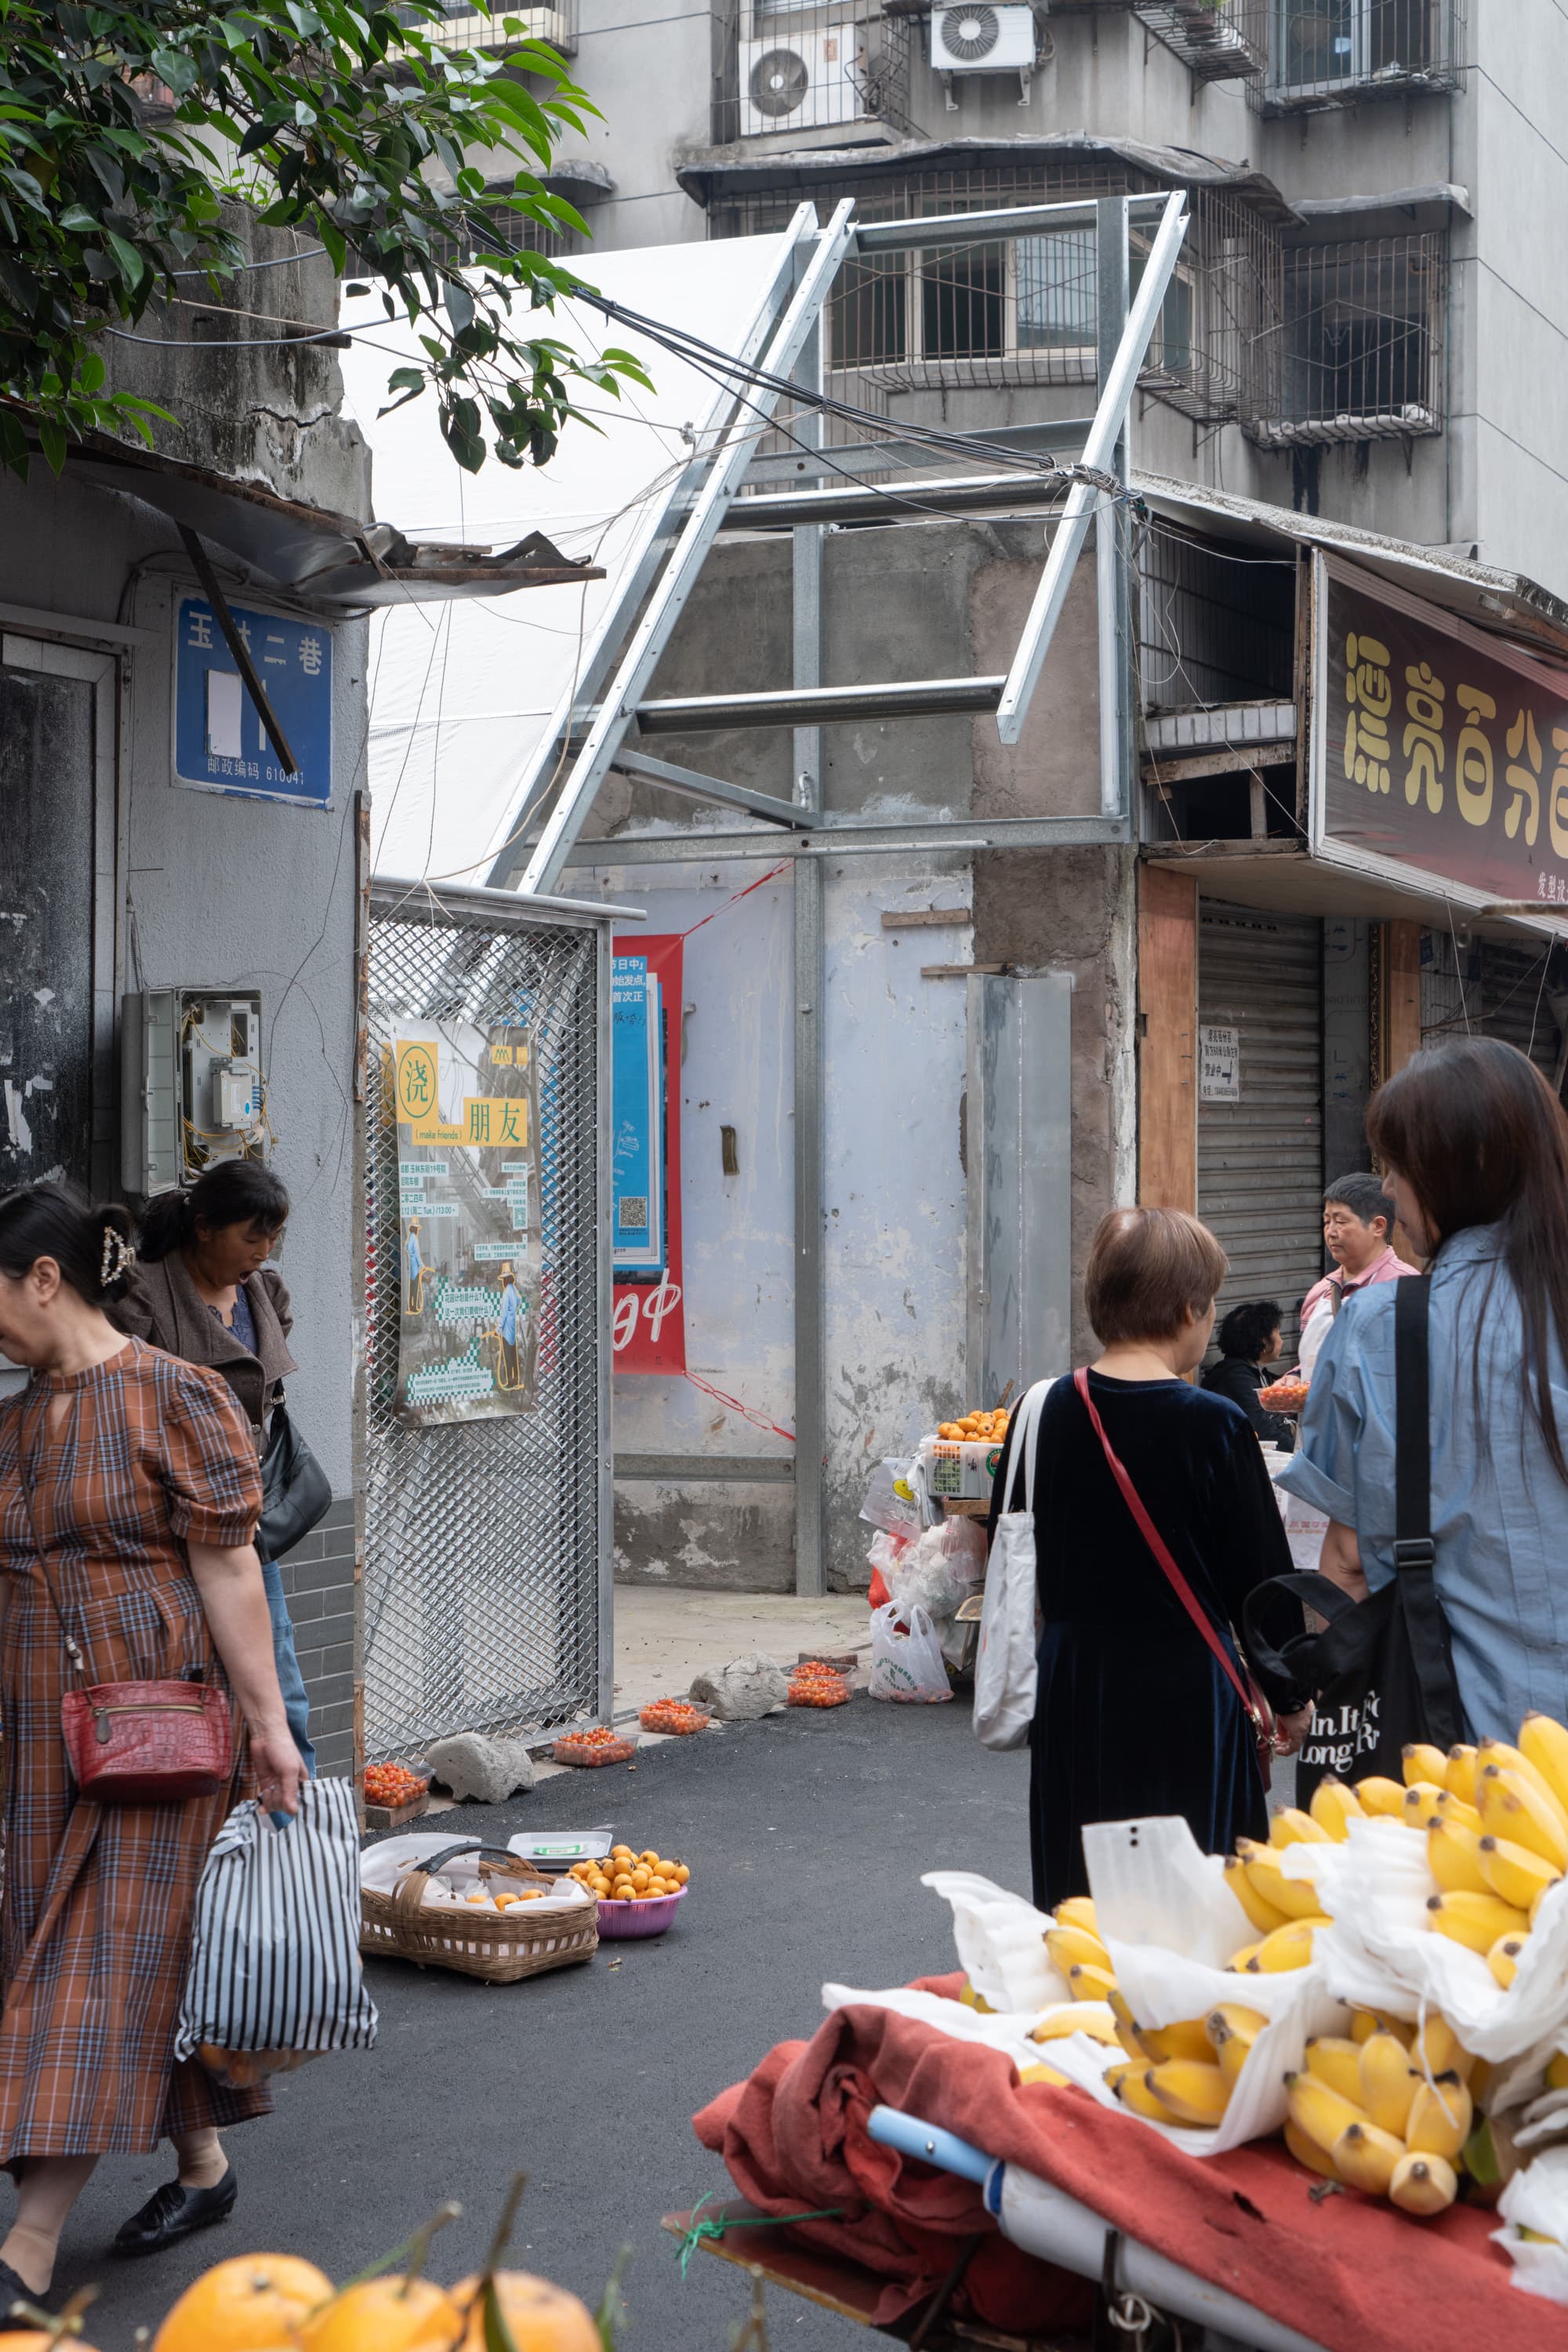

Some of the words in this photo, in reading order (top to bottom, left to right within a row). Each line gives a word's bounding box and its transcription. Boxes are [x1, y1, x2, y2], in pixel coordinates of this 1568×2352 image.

[207, 757, 260, 779] 邮政编码
[406, 1060, 428, 1103] 浇
[470, 1102, 521, 1142] 朋友
[1338, 1705, 1360, 1735] It
